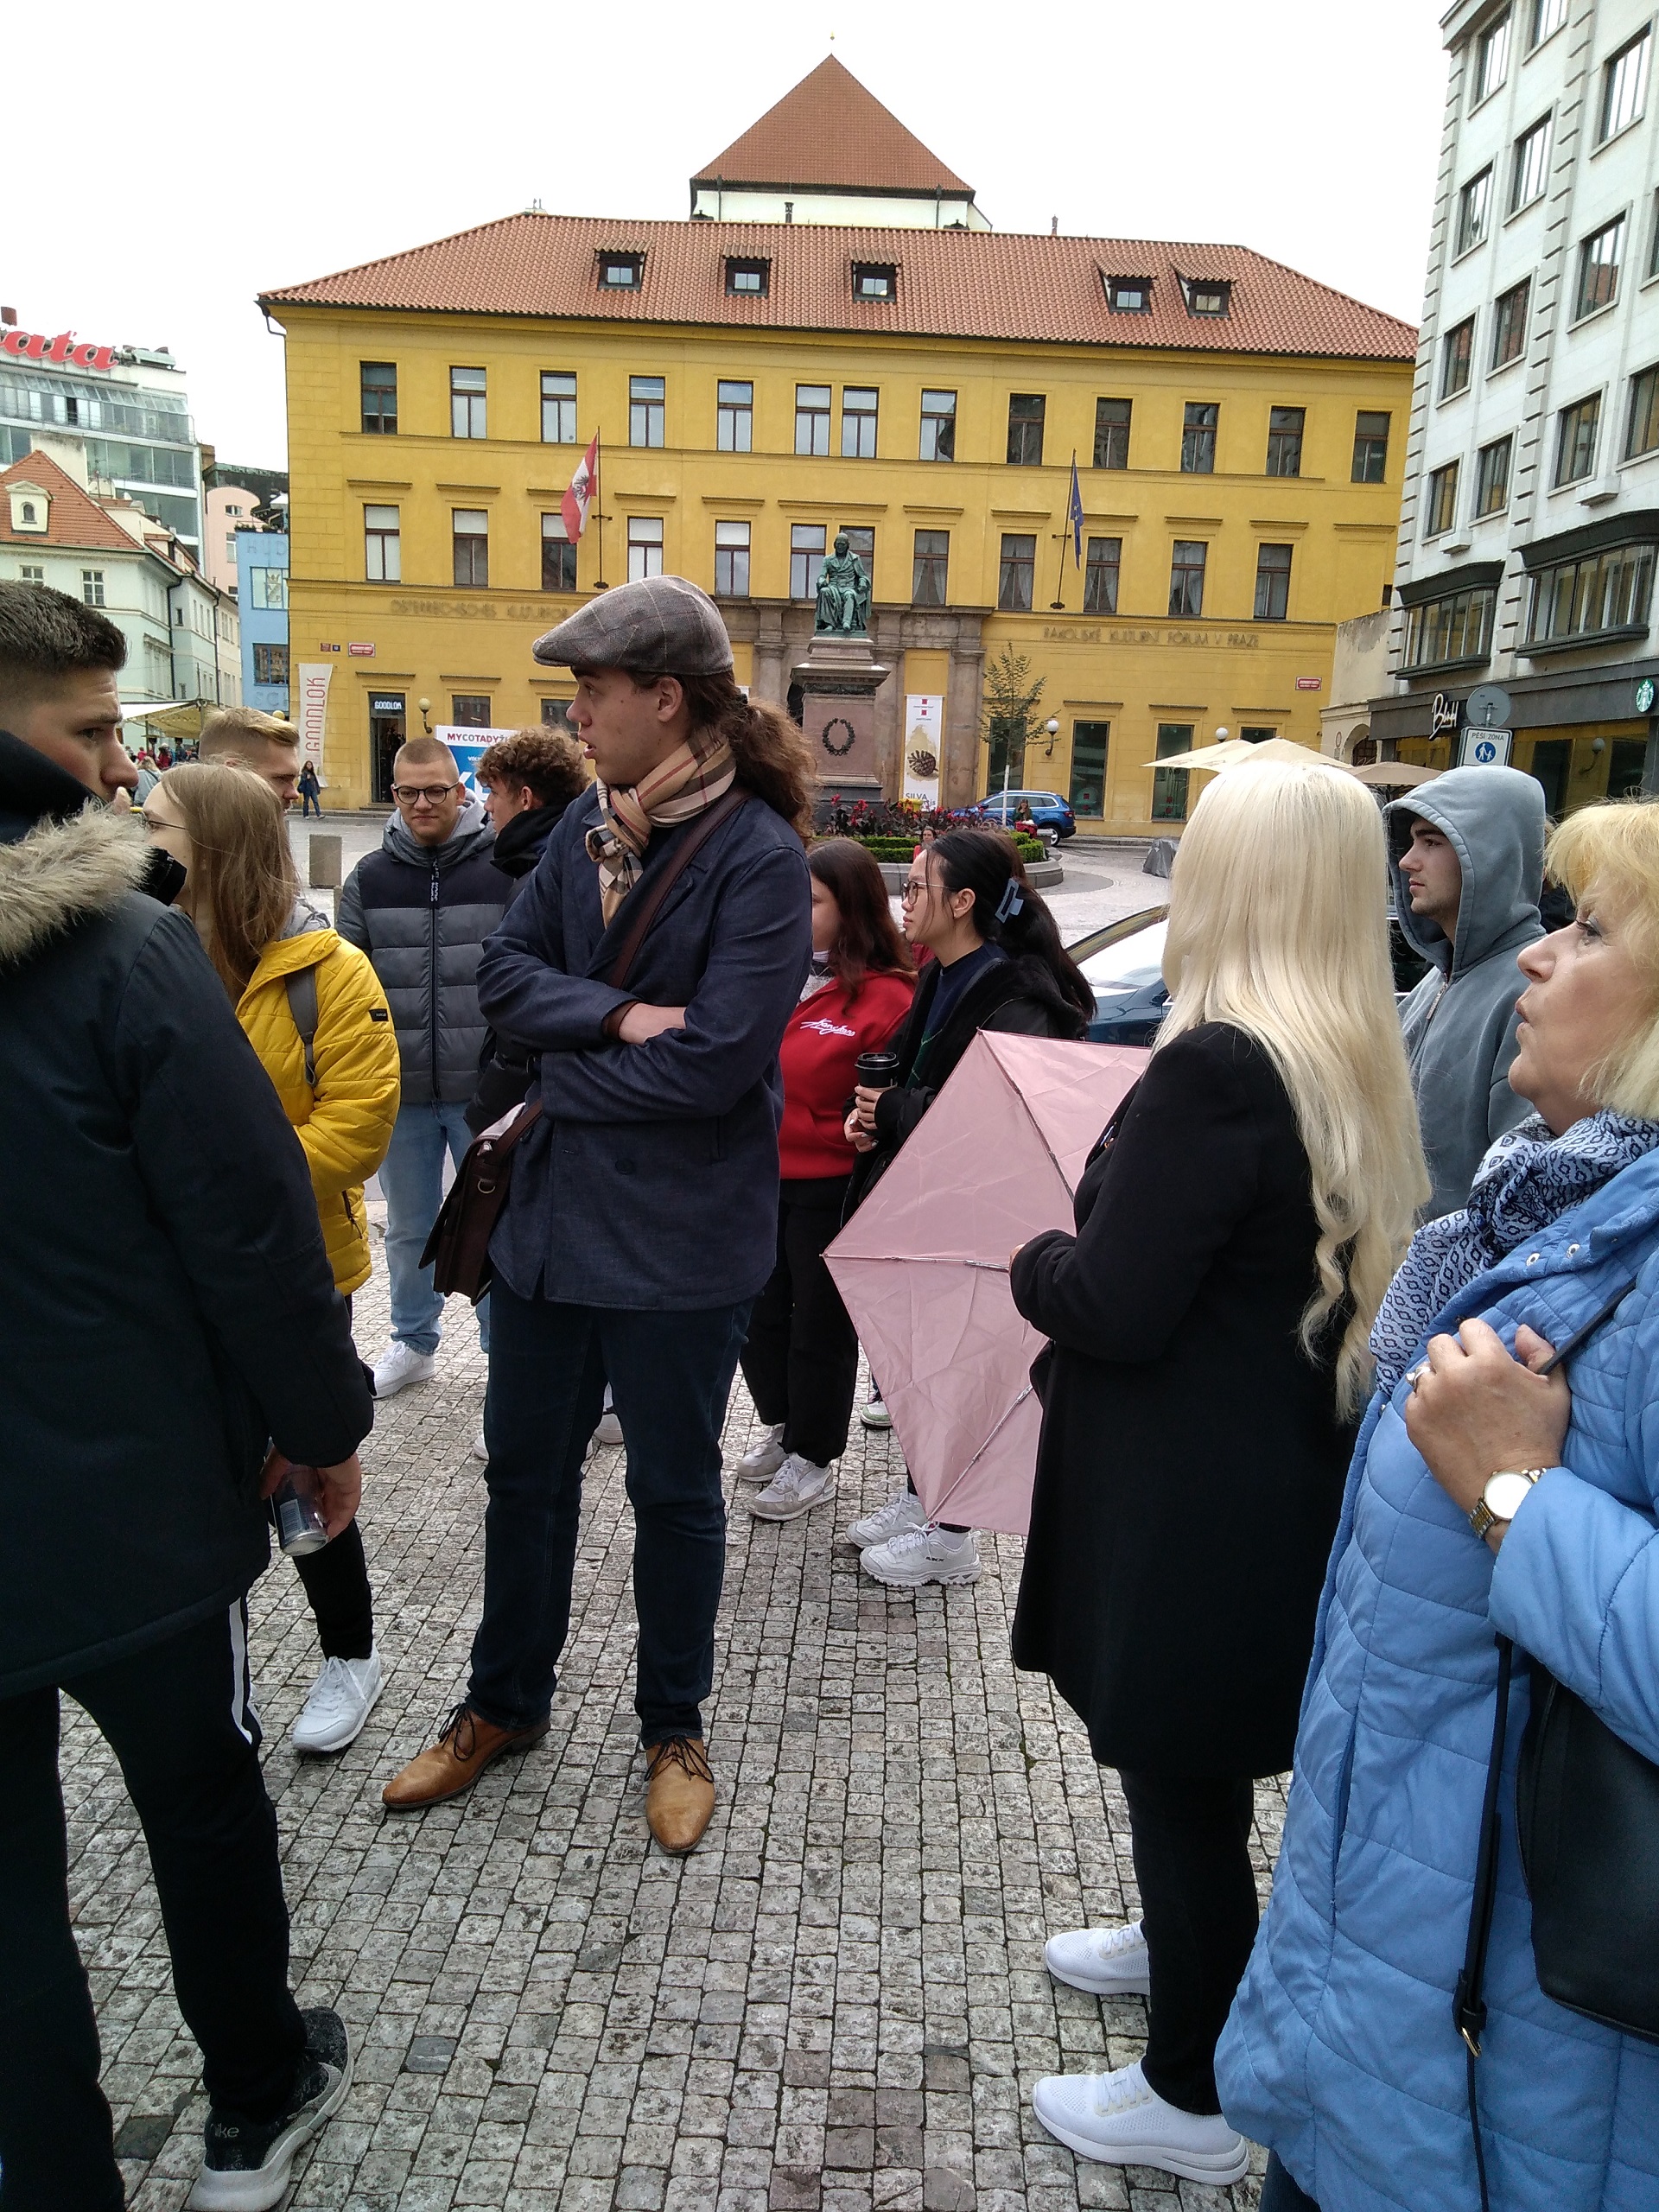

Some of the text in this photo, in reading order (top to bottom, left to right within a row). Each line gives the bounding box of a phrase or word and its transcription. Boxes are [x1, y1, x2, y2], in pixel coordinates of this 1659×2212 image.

[0, 330, 119, 371] aťa
[1214, 632, 1222, 645] V
[1227, 632, 1259, 648] PRAZE
[305, 677, 326, 753] GOODLOK
